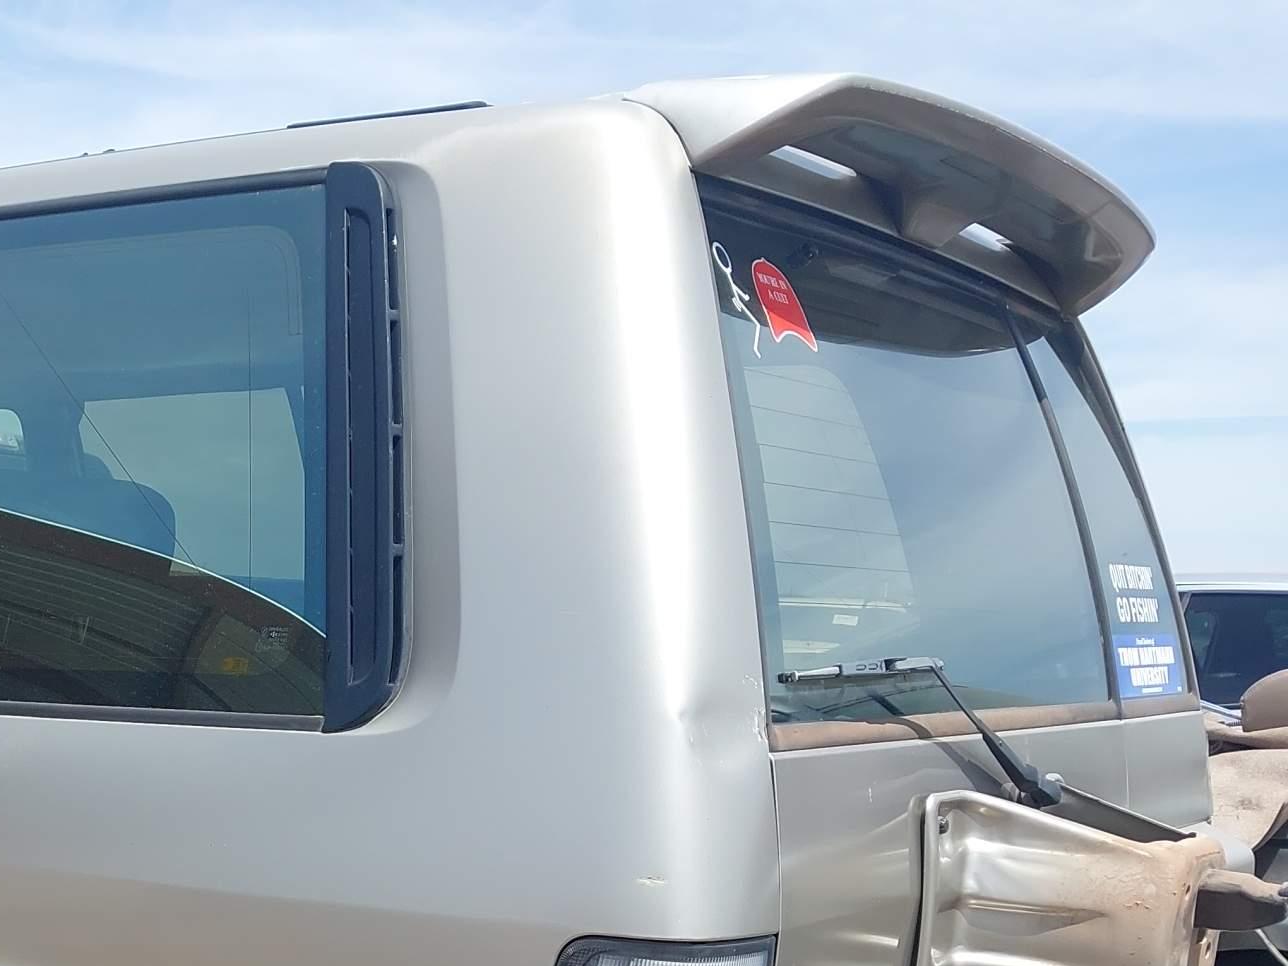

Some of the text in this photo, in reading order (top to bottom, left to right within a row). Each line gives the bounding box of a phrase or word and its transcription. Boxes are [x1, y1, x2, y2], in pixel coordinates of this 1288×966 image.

[1109, 563, 1127, 592] QUIT
[1116, 597, 1159, 623] GO FISHIN'
[1130, 666, 1169, 687] UNIVERSITY
